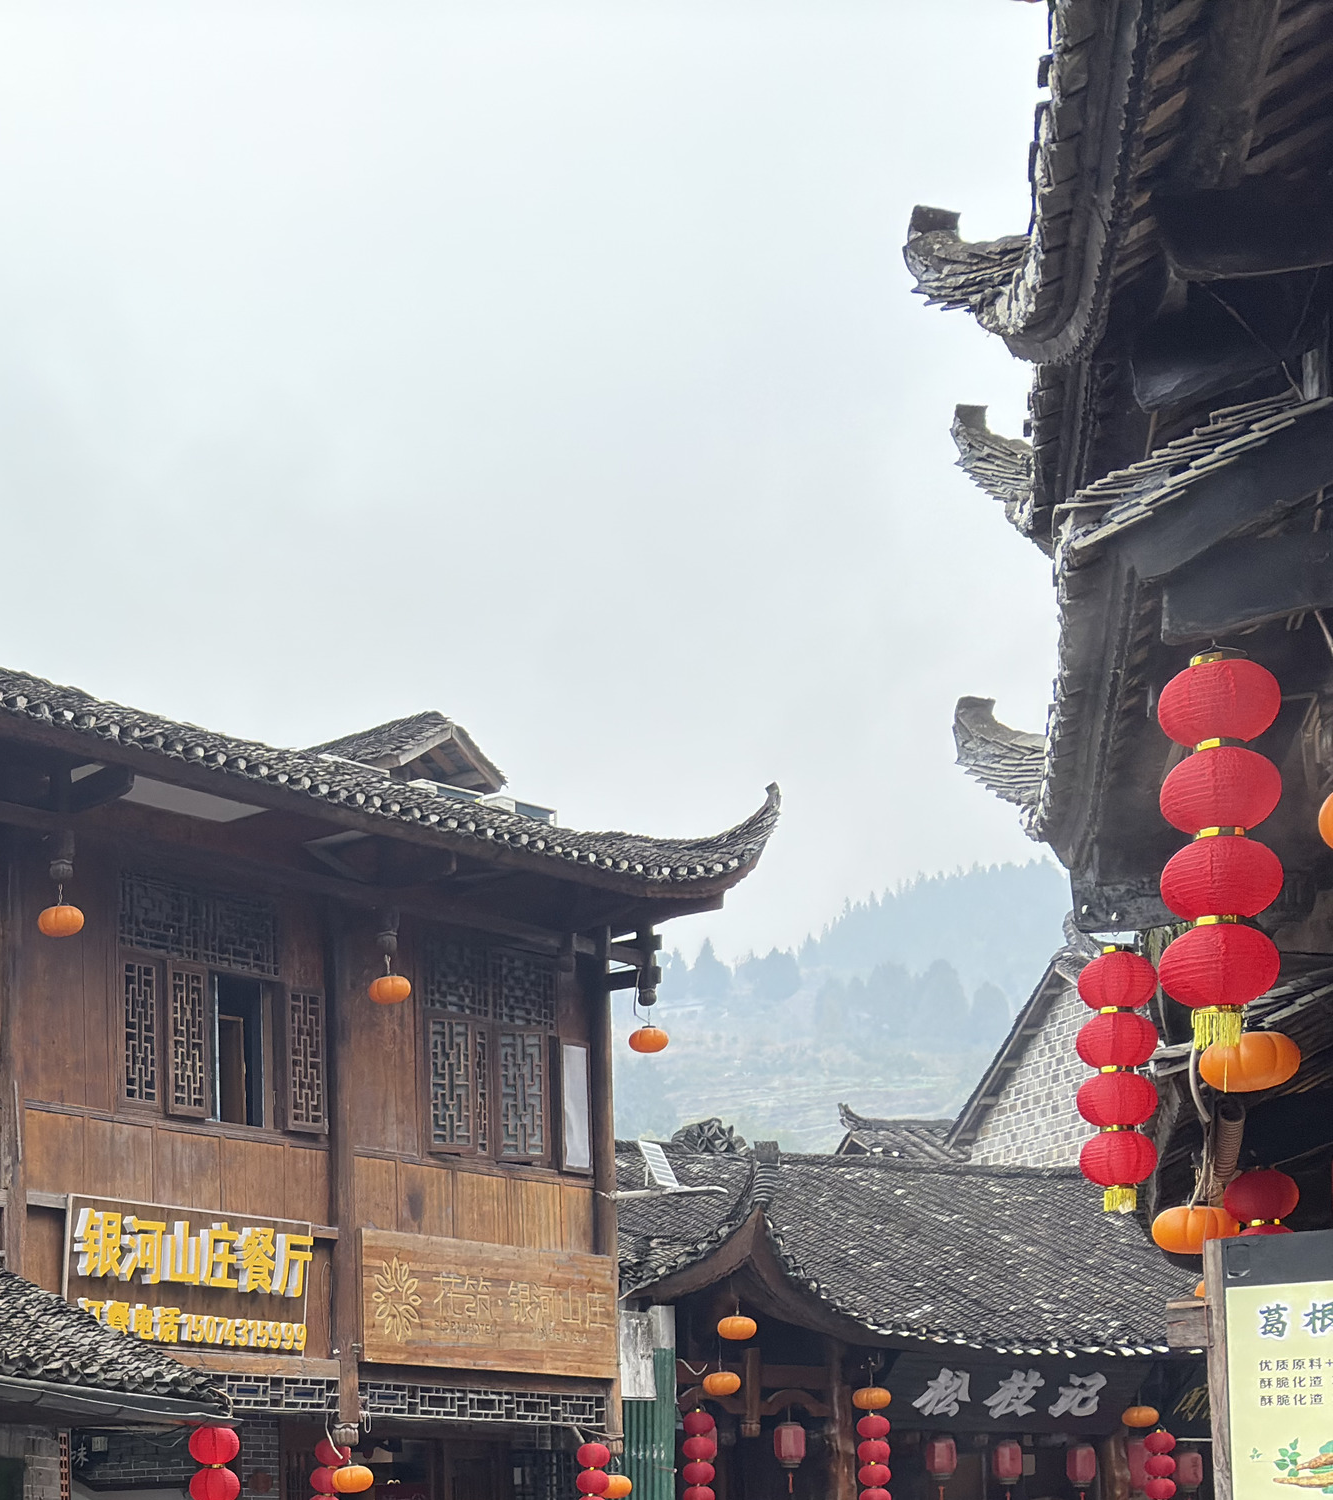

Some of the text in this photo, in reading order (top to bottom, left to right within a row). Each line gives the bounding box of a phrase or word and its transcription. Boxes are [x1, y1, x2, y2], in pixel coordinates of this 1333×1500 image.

[74, 1208, 313, 1298] 银河山庄餐厅
[1259, 1375, 1323, 1389] 酥脆化渣
[1260, 1393, 1324, 1407] 酥脆化渣
